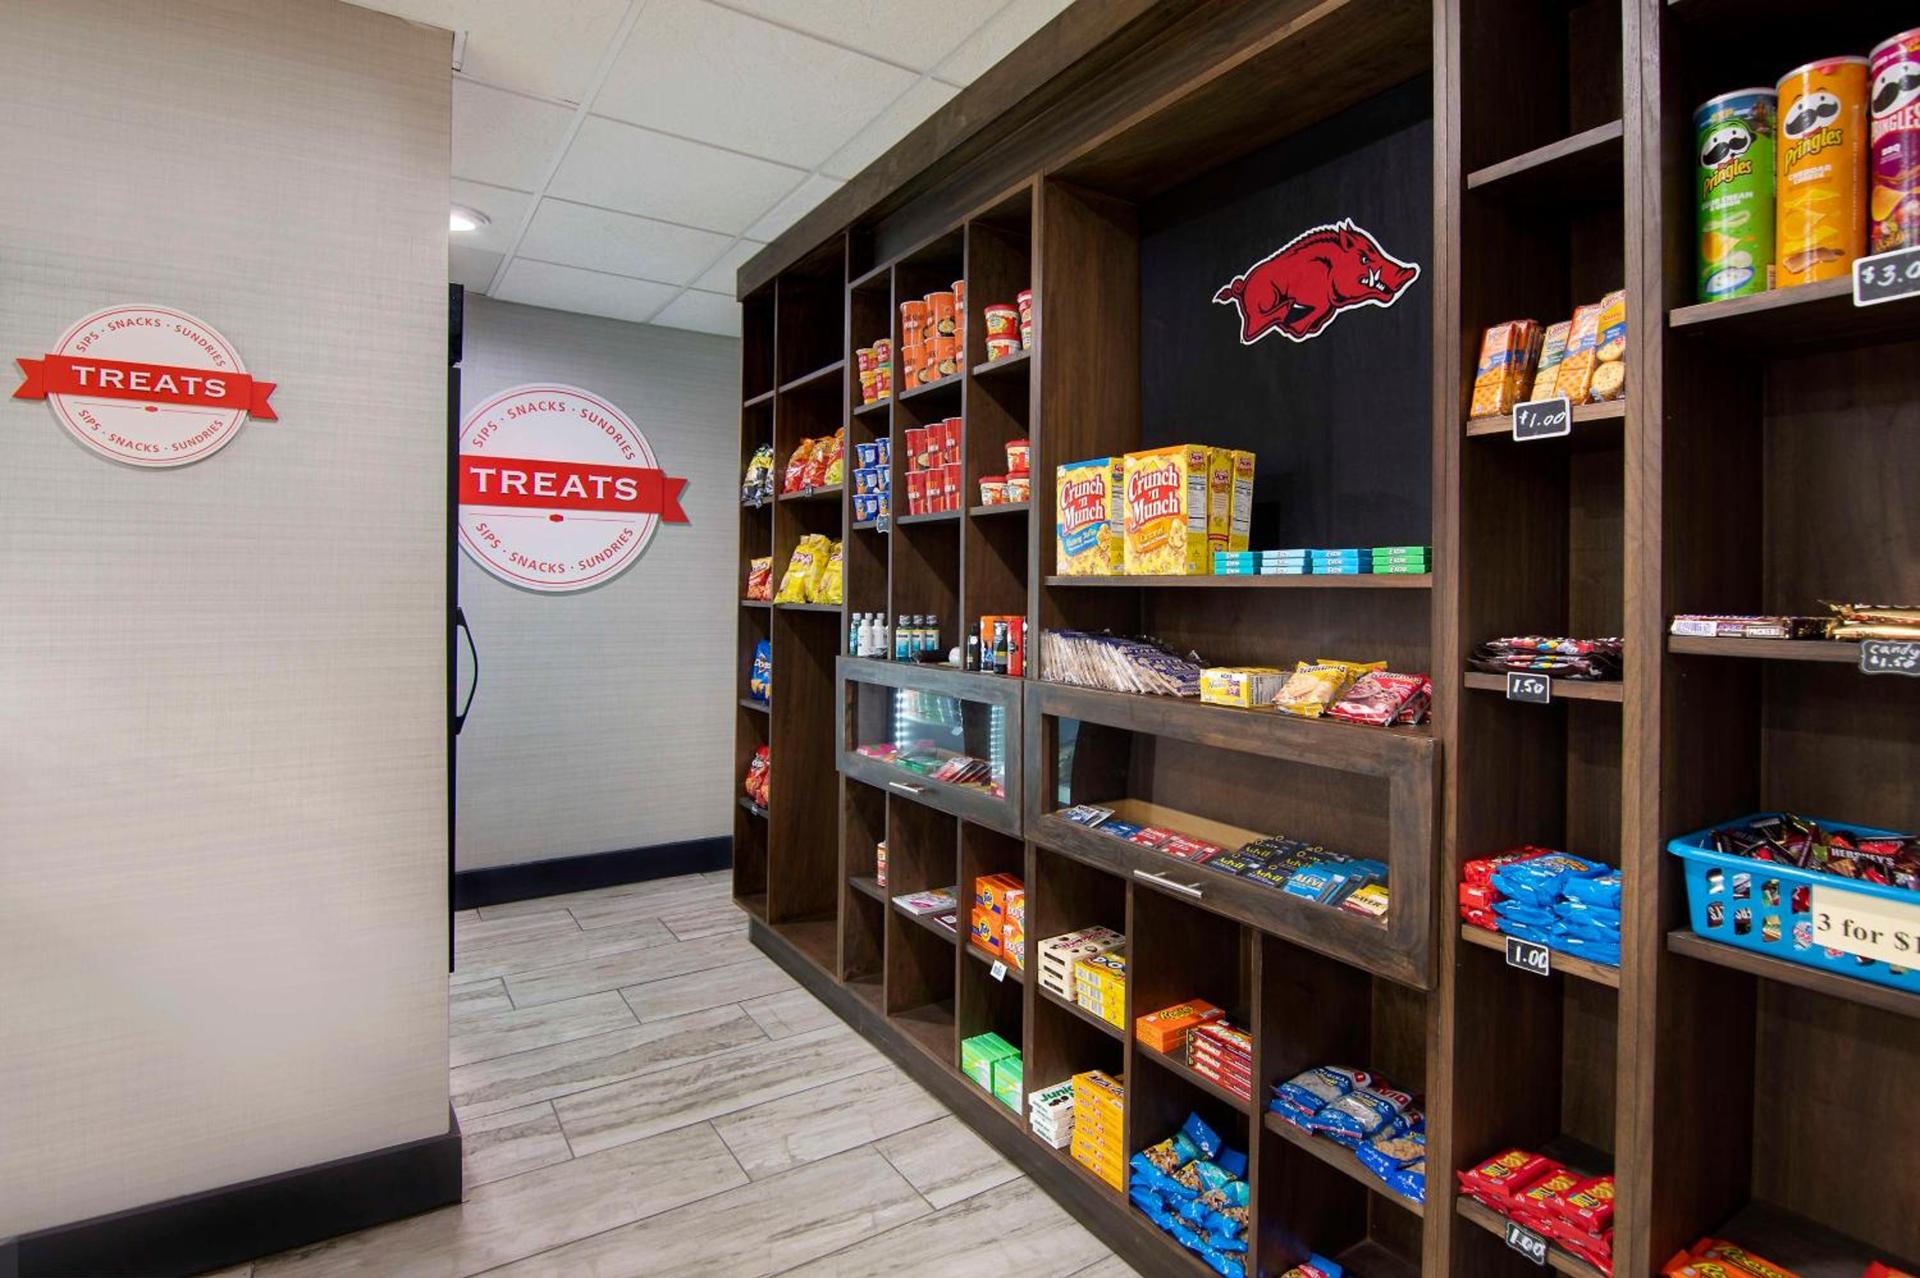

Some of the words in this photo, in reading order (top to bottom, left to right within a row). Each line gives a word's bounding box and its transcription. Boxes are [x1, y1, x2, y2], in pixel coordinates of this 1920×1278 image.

[1784, 128, 1843, 177] Pringles
[1703, 158, 1753, 201] Pringles
[76, 331, 100, 352] SIPS
[108, 316, 161, 332] SNACKS
[174, 323, 226, 368] SUNDRIES
[71, 365, 227, 398] TREATS
[78, 409, 102, 432] SIPS
[108, 432, 160, 453] SNACKS
[171, 419, 224, 452] SUNDRIES
[473, 420, 498, 449] SIPS
[507, 401, 566, 420] SNACKS
[579, 408, 636, 461] SUNDRIES
[470, 466, 639, 501] TREATS
[1060, 474, 1105, 507] Crunch
[1127, 463, 1179, 501] Crunch
[1063, 503, 1105, 533] Munch
[1131, 495, 1179, 532] Munch
[475, 522, 502, 549] SIPS
[508, 552, 566, 574] SNACKS
[578, 527, 634, 571] SUNDRIES
[1513, 678, 1545, 694] 1.50
[1817, 913, 1831, 932] 3
[1842, 919, 1884, 944] for
[1515, 945, 1548, 969] 1.00
[1040, 1085, 1074, 1102] Junio
